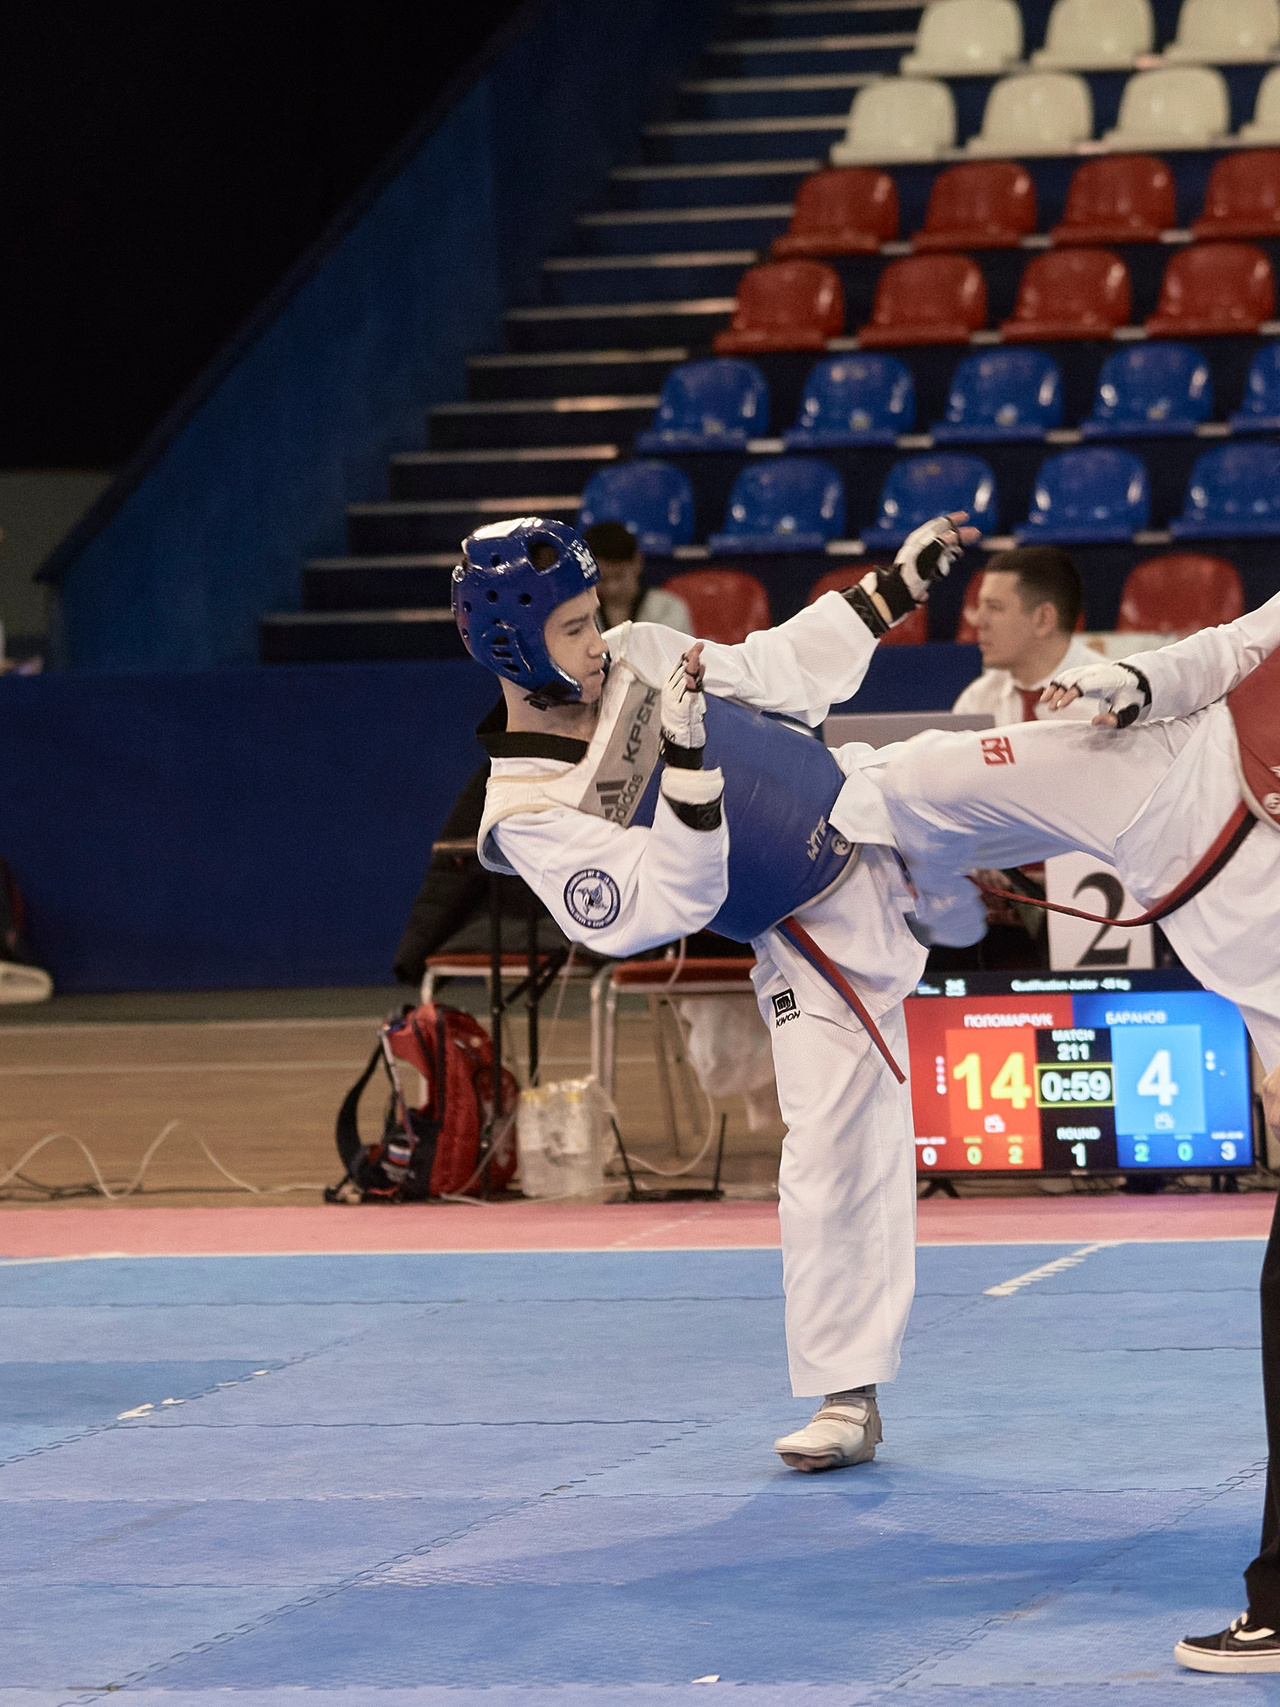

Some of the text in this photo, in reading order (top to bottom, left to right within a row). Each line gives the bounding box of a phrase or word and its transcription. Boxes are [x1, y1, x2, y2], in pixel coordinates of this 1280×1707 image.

[834, 838, 848, 850] 3
[1072, 872, 1131, 967] 2
[1105, 1011, 1167, 1025] БАРАНОВ
[1052, 1029, 1095, 1042] MATCH
[1057, 1043, 1089, 1061] 211
[953, 1052, 1032, 1110] 14
[1041, 1071, 1111, 1102] 0:59
[1137, 1049, 1179, 1106] 4
[1057, 1127, 1101, 1140] ROUND
[922, 1146, 937, 1166] 0
[967, 1146, 982, 1165] 0
[1008, 1145, 1023, 1164] 2
[1071, 1142, 1086, 1167] 1
[1134, 1142, 1149, 1162] 2
[1177, 1142, 1193, 1162] 0
[1221, 1141, 1237, 1161] 3
